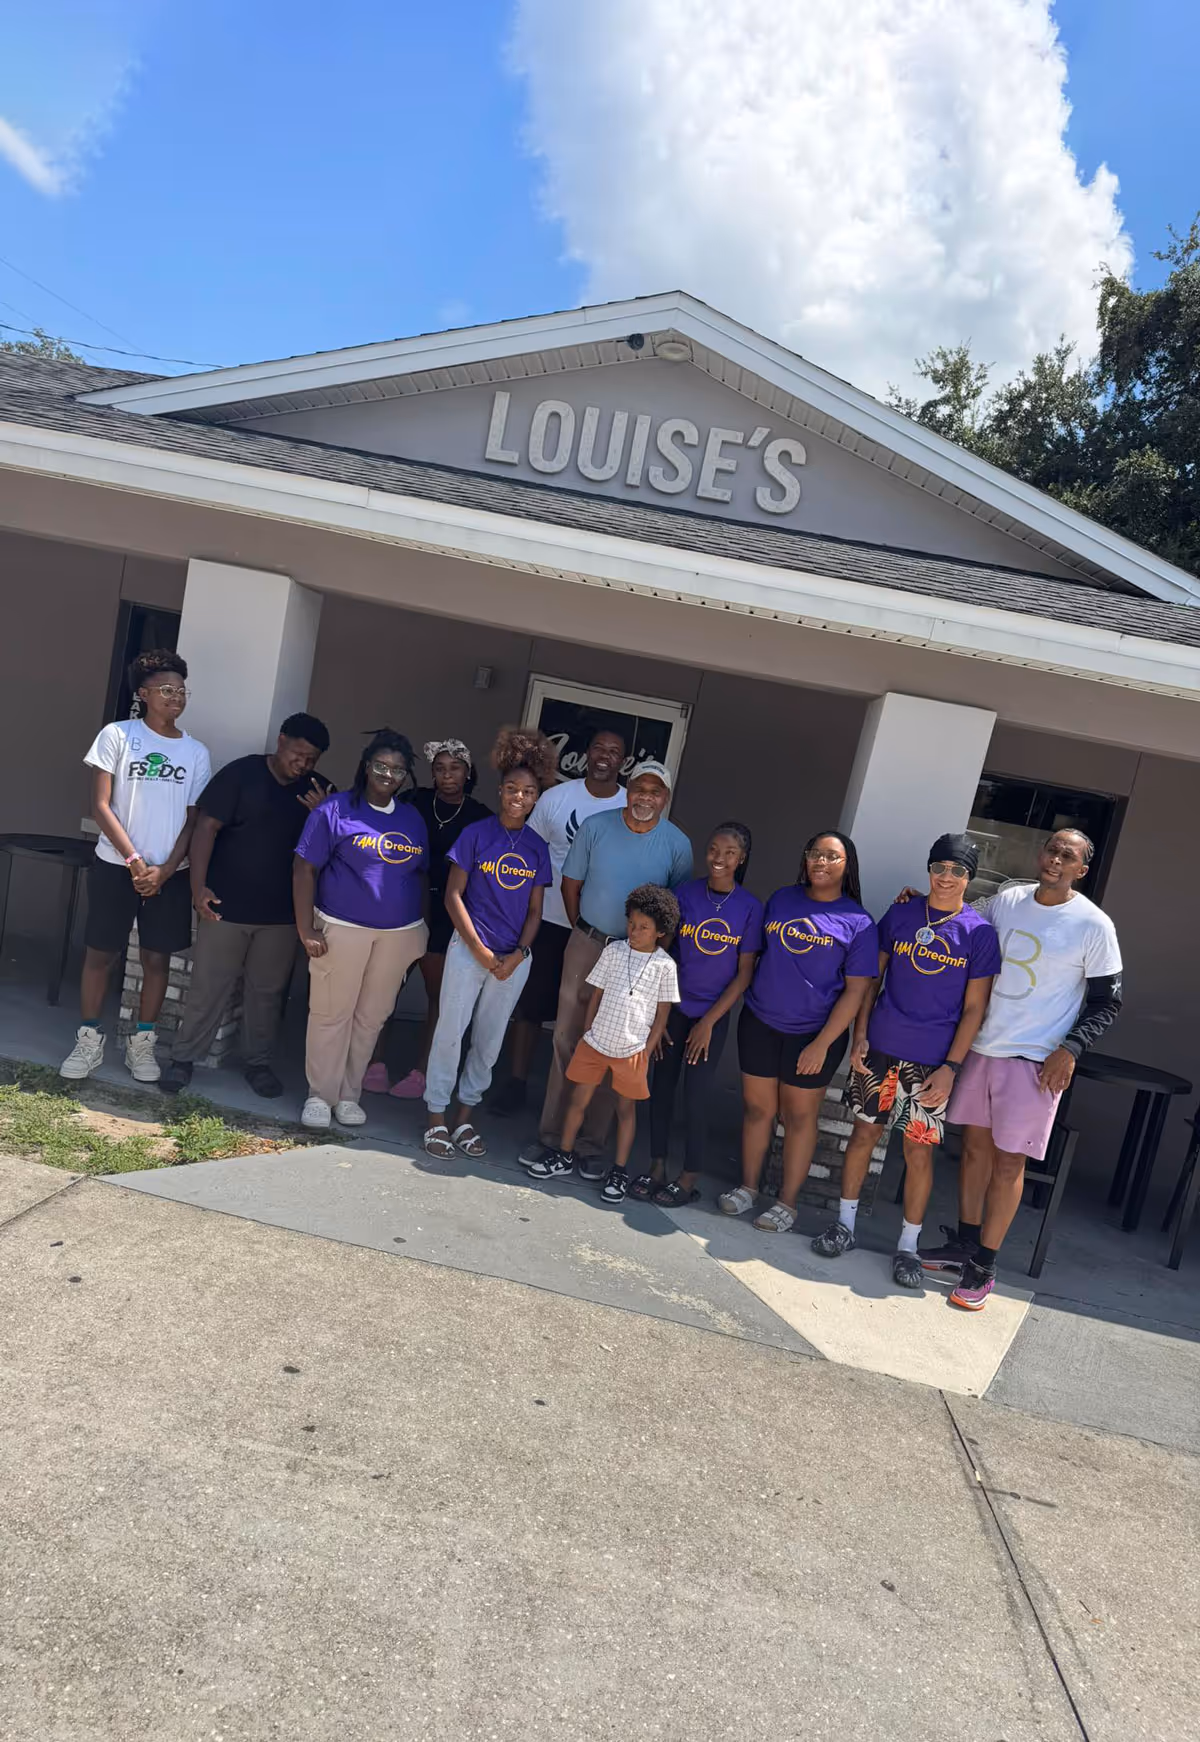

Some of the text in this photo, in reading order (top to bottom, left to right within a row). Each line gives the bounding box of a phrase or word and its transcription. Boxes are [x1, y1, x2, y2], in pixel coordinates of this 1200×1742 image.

[485, 391, 807, 514] LOUISE'S
[357, 836, 377, 849] AM
[701, 929, 742, 945] DreamF
[787, 926, 834, 947] DreamFi
[896, 941, 913, 956] AM
[917, 946, 968, 968] DreamFi
